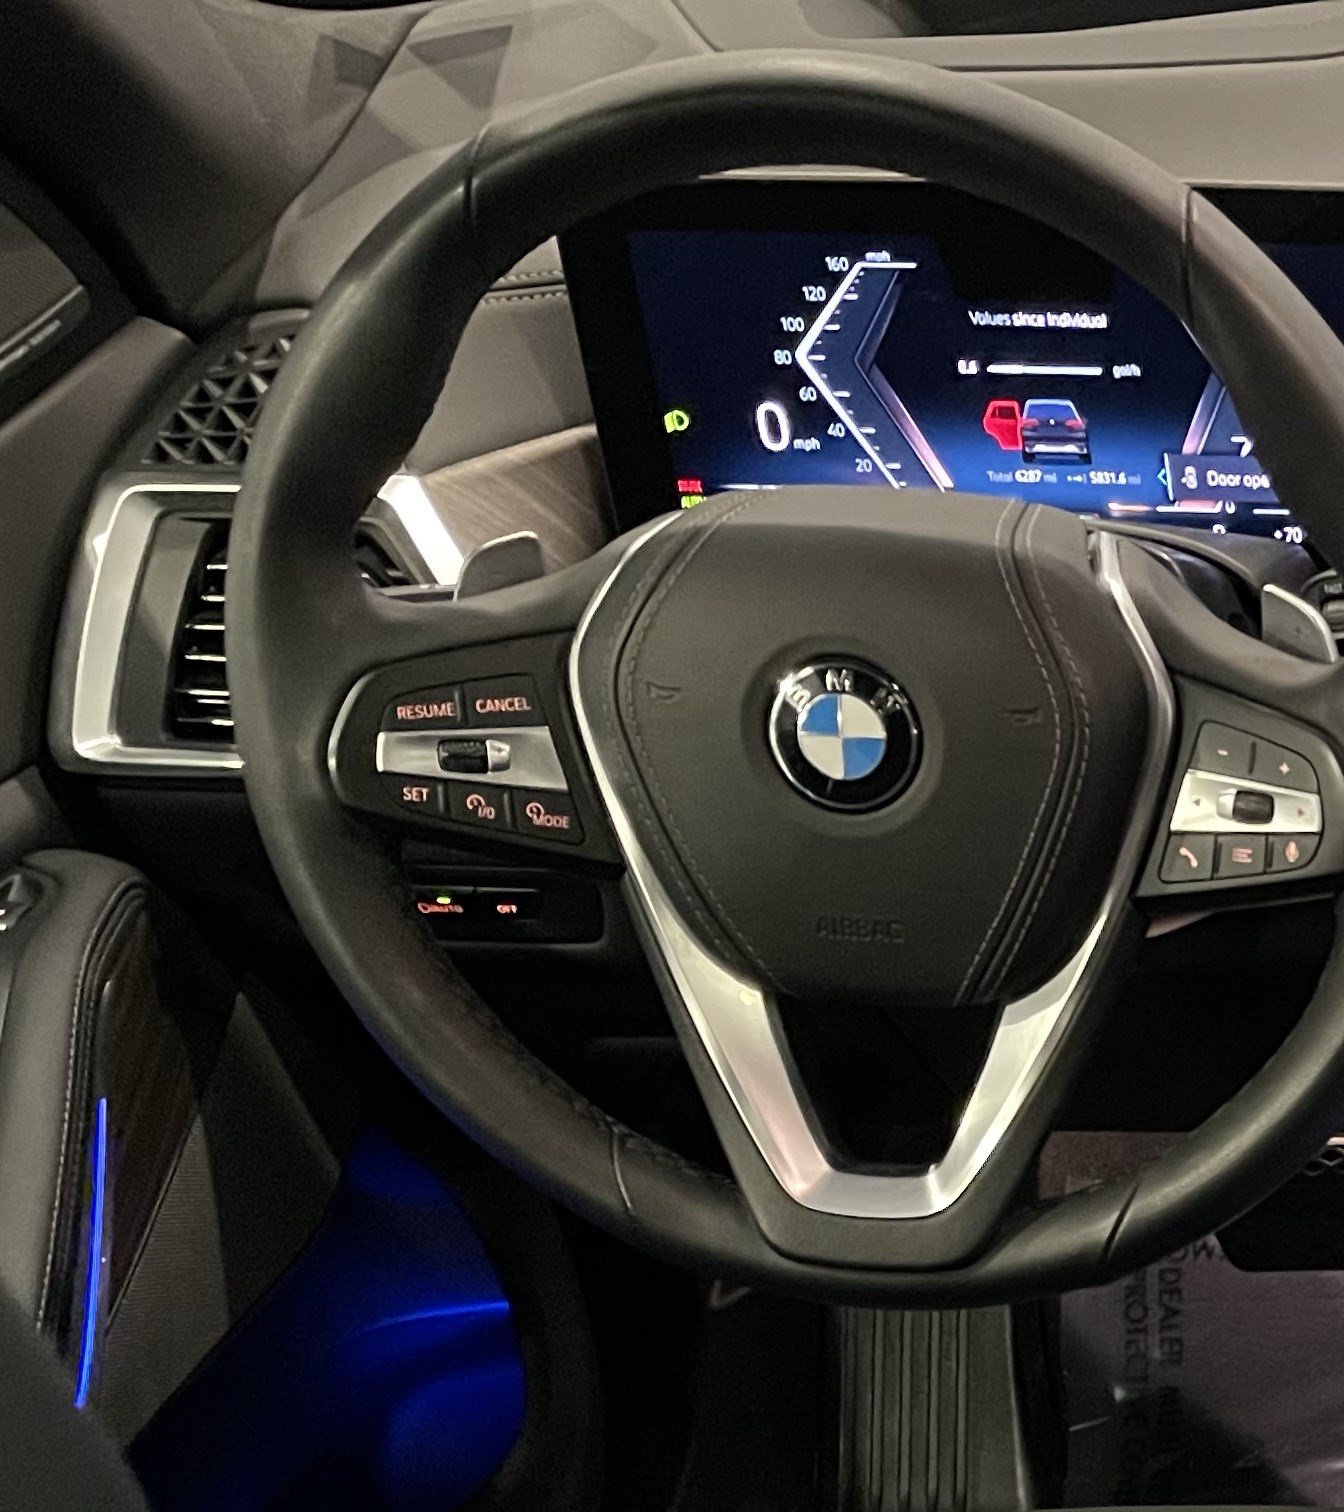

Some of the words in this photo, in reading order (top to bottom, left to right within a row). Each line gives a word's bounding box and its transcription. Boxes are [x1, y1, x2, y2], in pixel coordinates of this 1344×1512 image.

[825, 256, 849, 272] 160
[802, 286, 826, 302] 120
[780, 317, 805, 332] 100
[968, 310, 1011, 326] Values
[1012, 312, 1045, 327] since
[773, 350, 792, 365] 80
[799, 386, 817, 402] 60
[756, 401, 791, 452] 0
[793, 437, 821, 452] mph
[827, 423, 846, 438] 40
[855, 459, 873, 473] 20
[987, 470, 1013, 482] Total
[1206, 469, 1241, 488] Door
[397, 702, 455, 720] RESUME
[476, 696, 531, 713] CANCEL
[403, 787, 429, 802] SET
[532, 812, 570, 829] MODE
[816, 916, 905, 943] AIRBAG
[1158, 1267, 1182, 1366] DEALER
